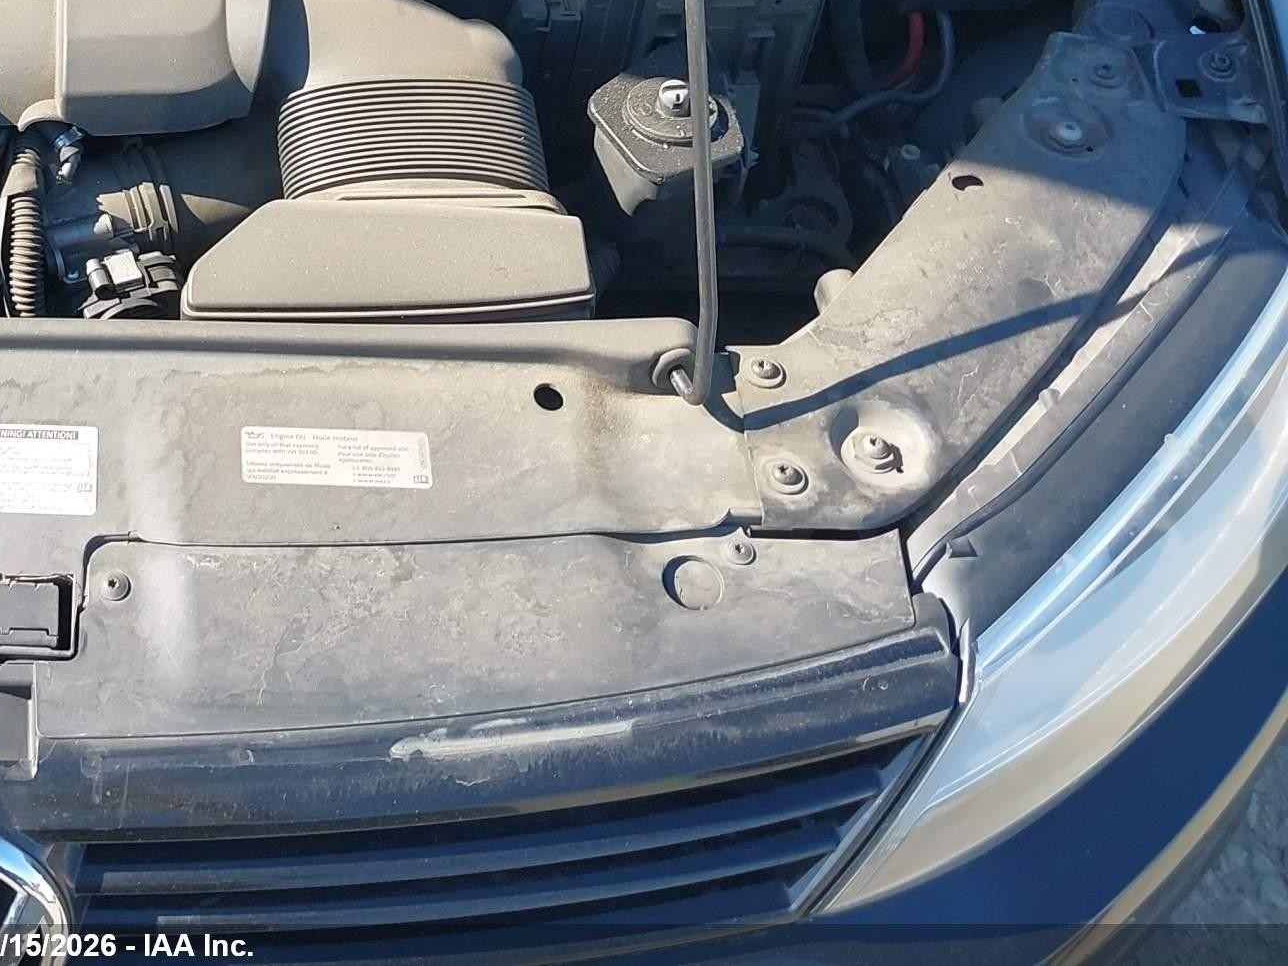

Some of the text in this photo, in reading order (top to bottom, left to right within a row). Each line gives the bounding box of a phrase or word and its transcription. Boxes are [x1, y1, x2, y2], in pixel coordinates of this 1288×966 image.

[27, 430, 77, 440] ATTENTION!
[270, 433, 294, 442] Engine
[312, 433, 331, 441] Huile
